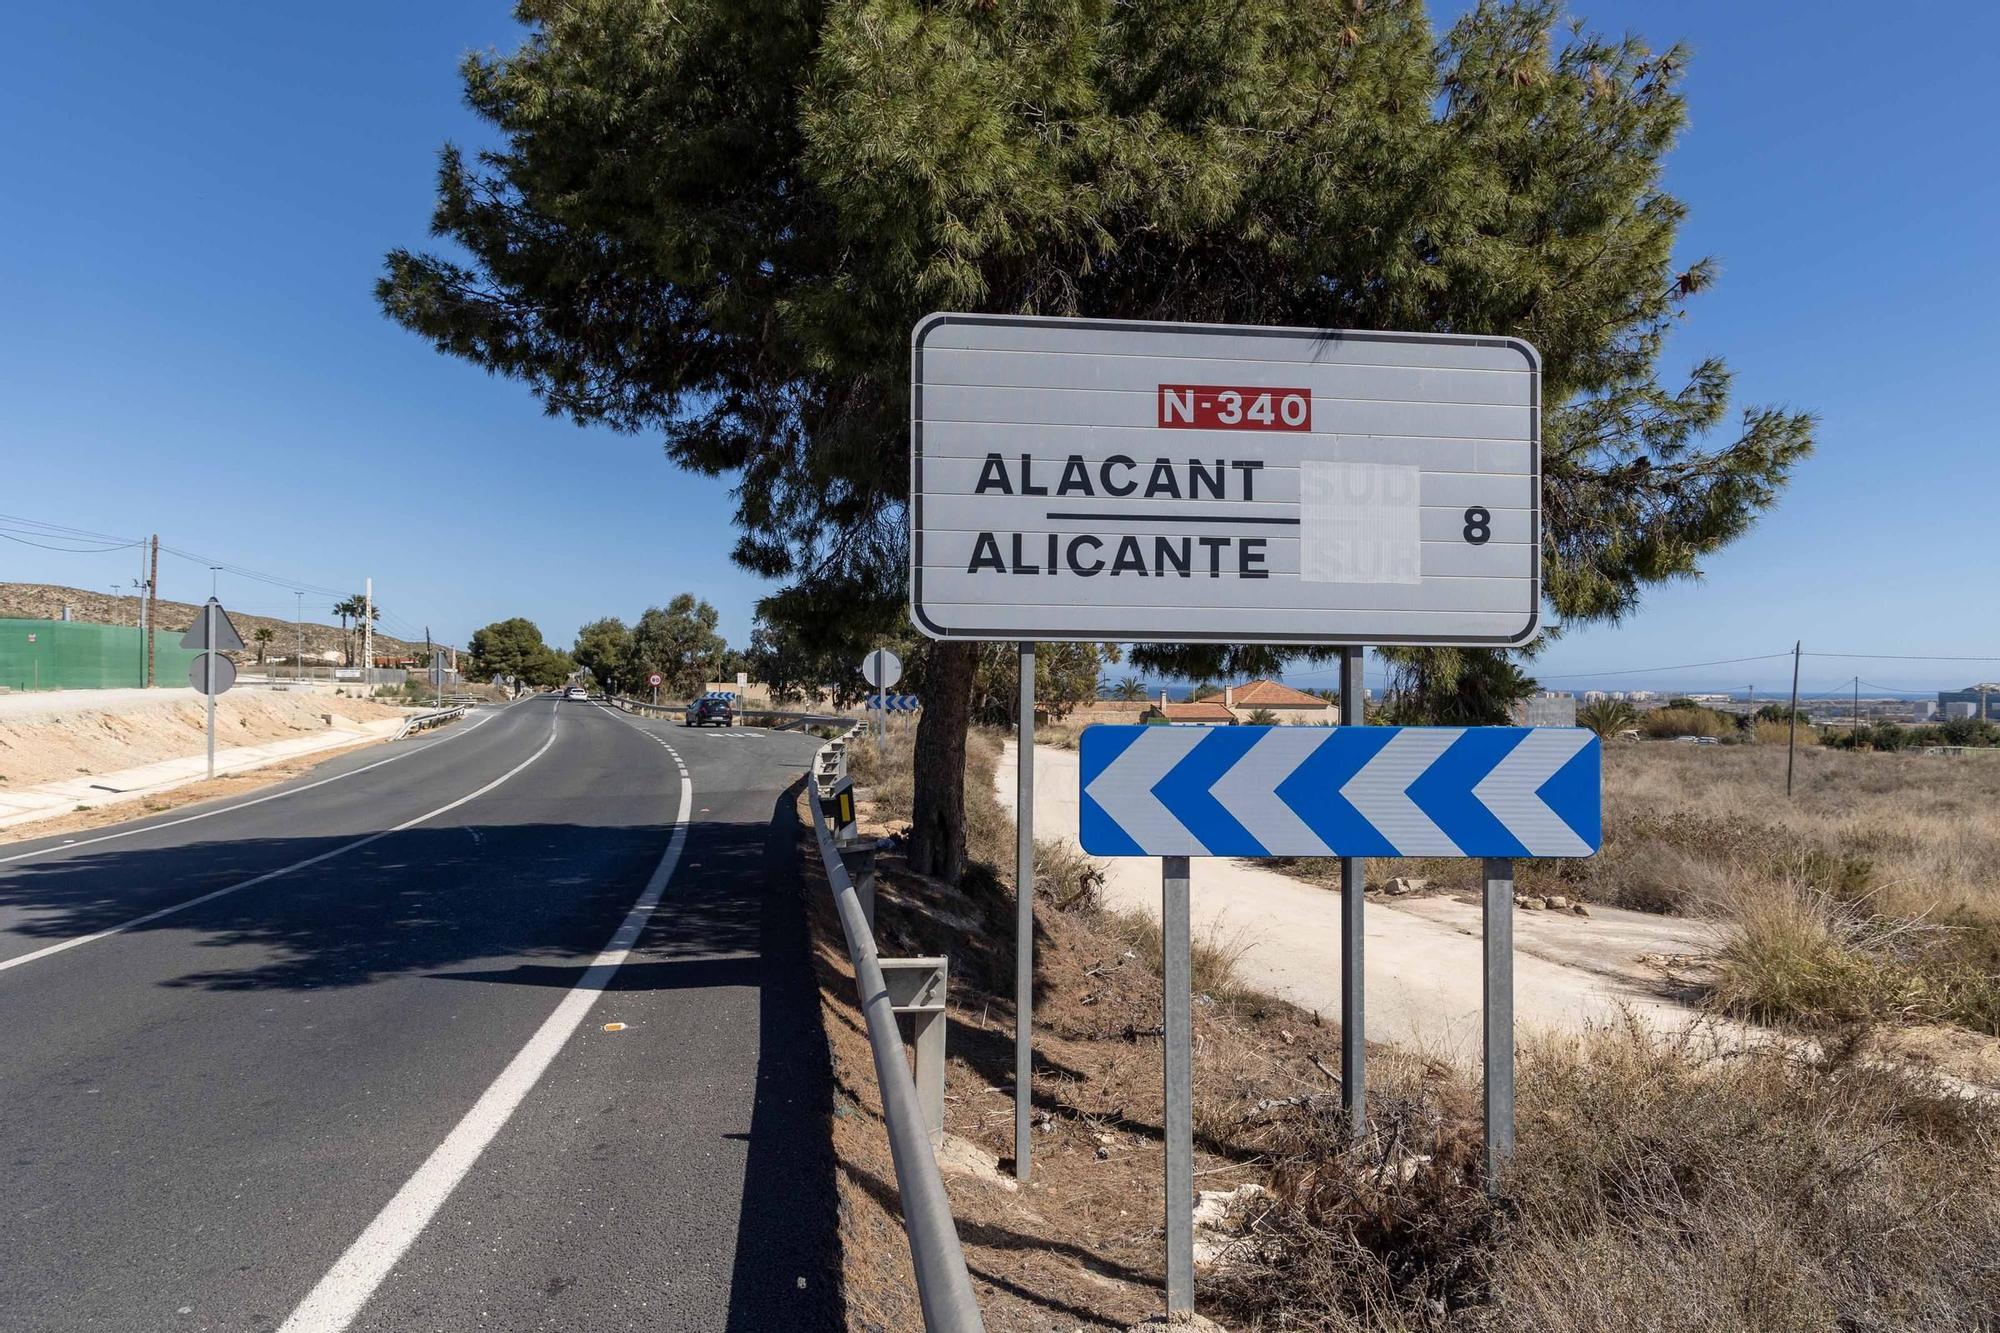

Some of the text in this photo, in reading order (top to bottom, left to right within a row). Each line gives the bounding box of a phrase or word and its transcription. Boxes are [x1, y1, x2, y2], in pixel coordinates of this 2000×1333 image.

[1163, 388, 1309, 427] N-340
[975, 453, 1264, 501] ALACANT
[1462, 505, 1491, 546] 8
[967, 531, 1270, 579] ALICANTE
